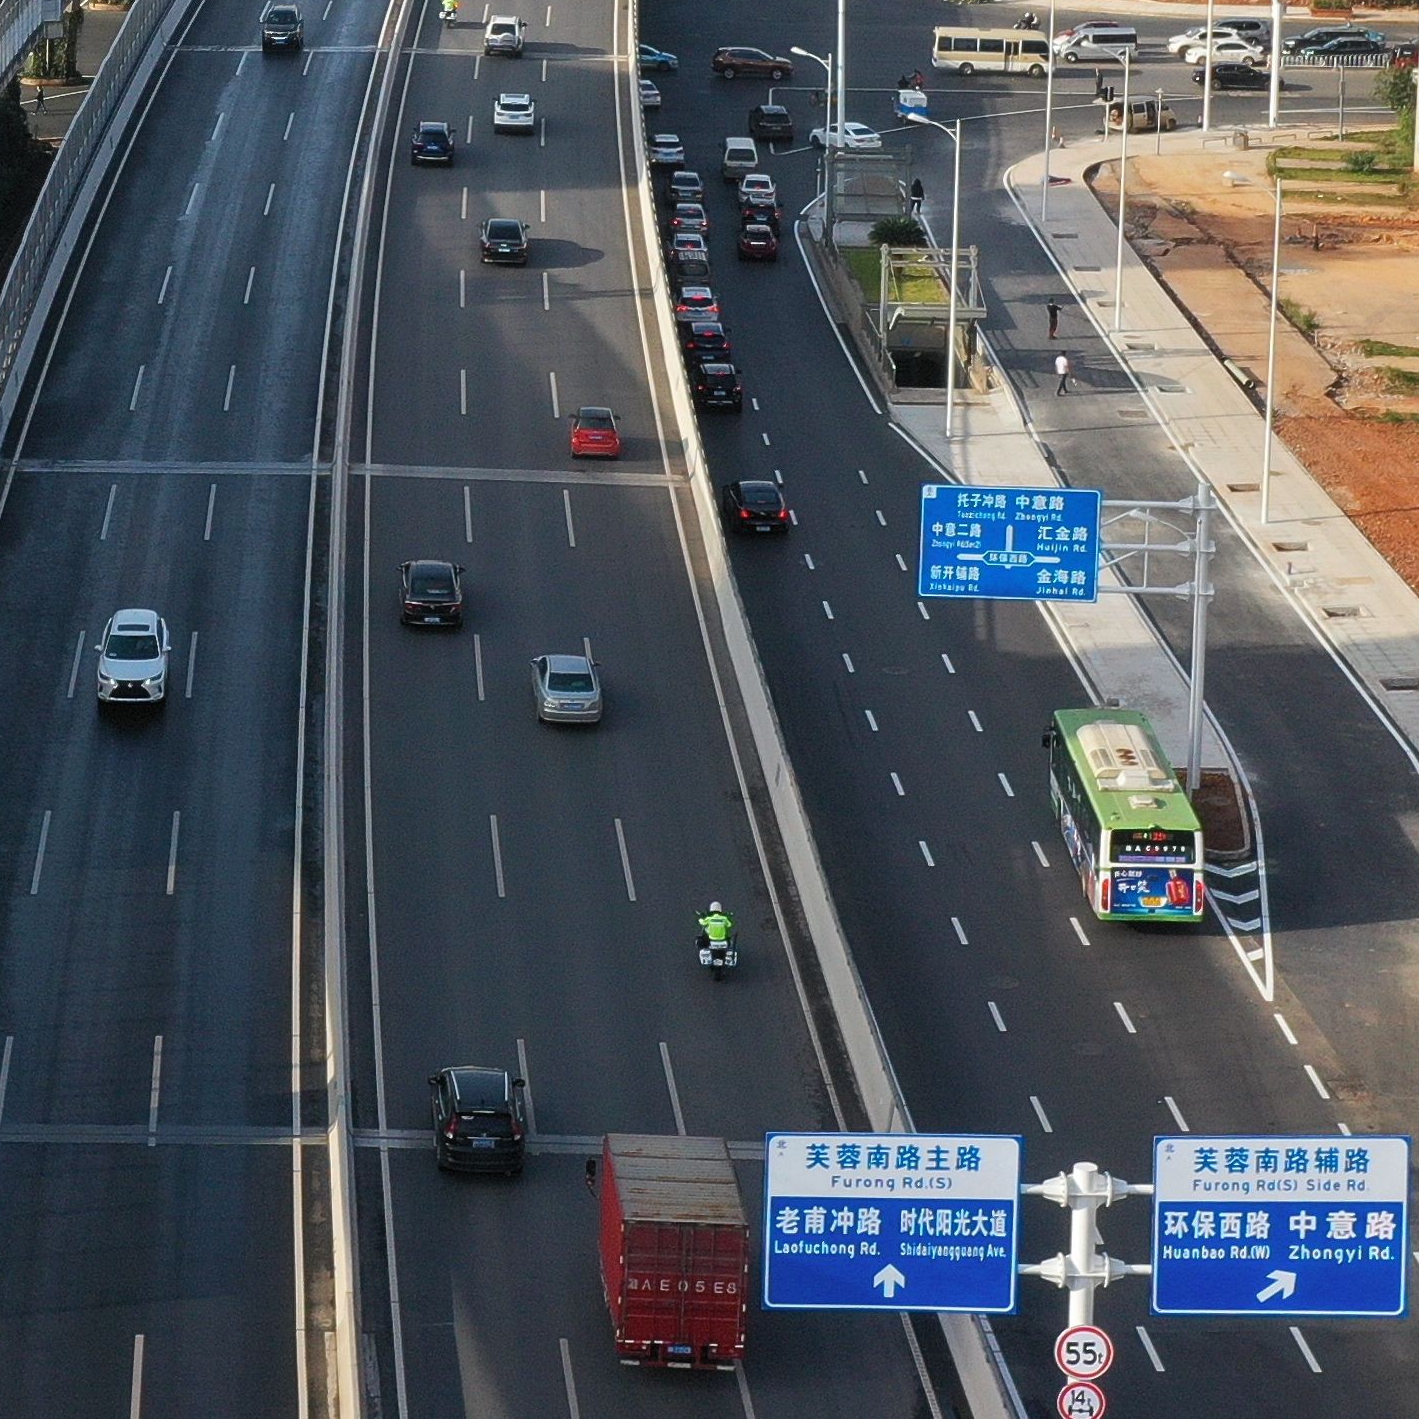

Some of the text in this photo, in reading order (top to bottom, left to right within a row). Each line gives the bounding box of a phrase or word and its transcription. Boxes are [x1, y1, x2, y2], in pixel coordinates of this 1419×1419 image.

[957, 492, 1065, 511] 托子冲路 中意路
[1015, 512, 1049, 523] Zhongyi
[932, 521, 982, 538] 中意二路
[1037, 526, 1088, 541] 汇金路
[1036, 543, 1069, 554] Huijin
[1036, 568, 1087, 585] 金海路
[1036, 586, 1086, 596] Jinhai Rd.
[776, 1139, 787, 1150] 北
[1164, 1143, 1175, 1154] 北
[804, 1142, 983, 1173] 芙蓉南路主路
[1193, 1146, 1371, 1174] 芙蓉南路辅路
[831, 1175, 953, 1193] Furong Rd.(S)
[1192, 1179, 1250, 1195] Furong
[1306, 1179, 1341, 1192] Side
[775, 1206, 1008, 1238] 老甫冲路 时代阳光大道
[1164, 1209, 1397, 1241] 环保西路 中意路
[774, 1240, 1007, 1262] Laofuchong Rd. Shidaiyangguang Ave.
[1163, 1245, 1396, 1264] Huanbao Rd.(W) Zhongyi Rd.
[1065, 1341, 1104, 1365] 55t
